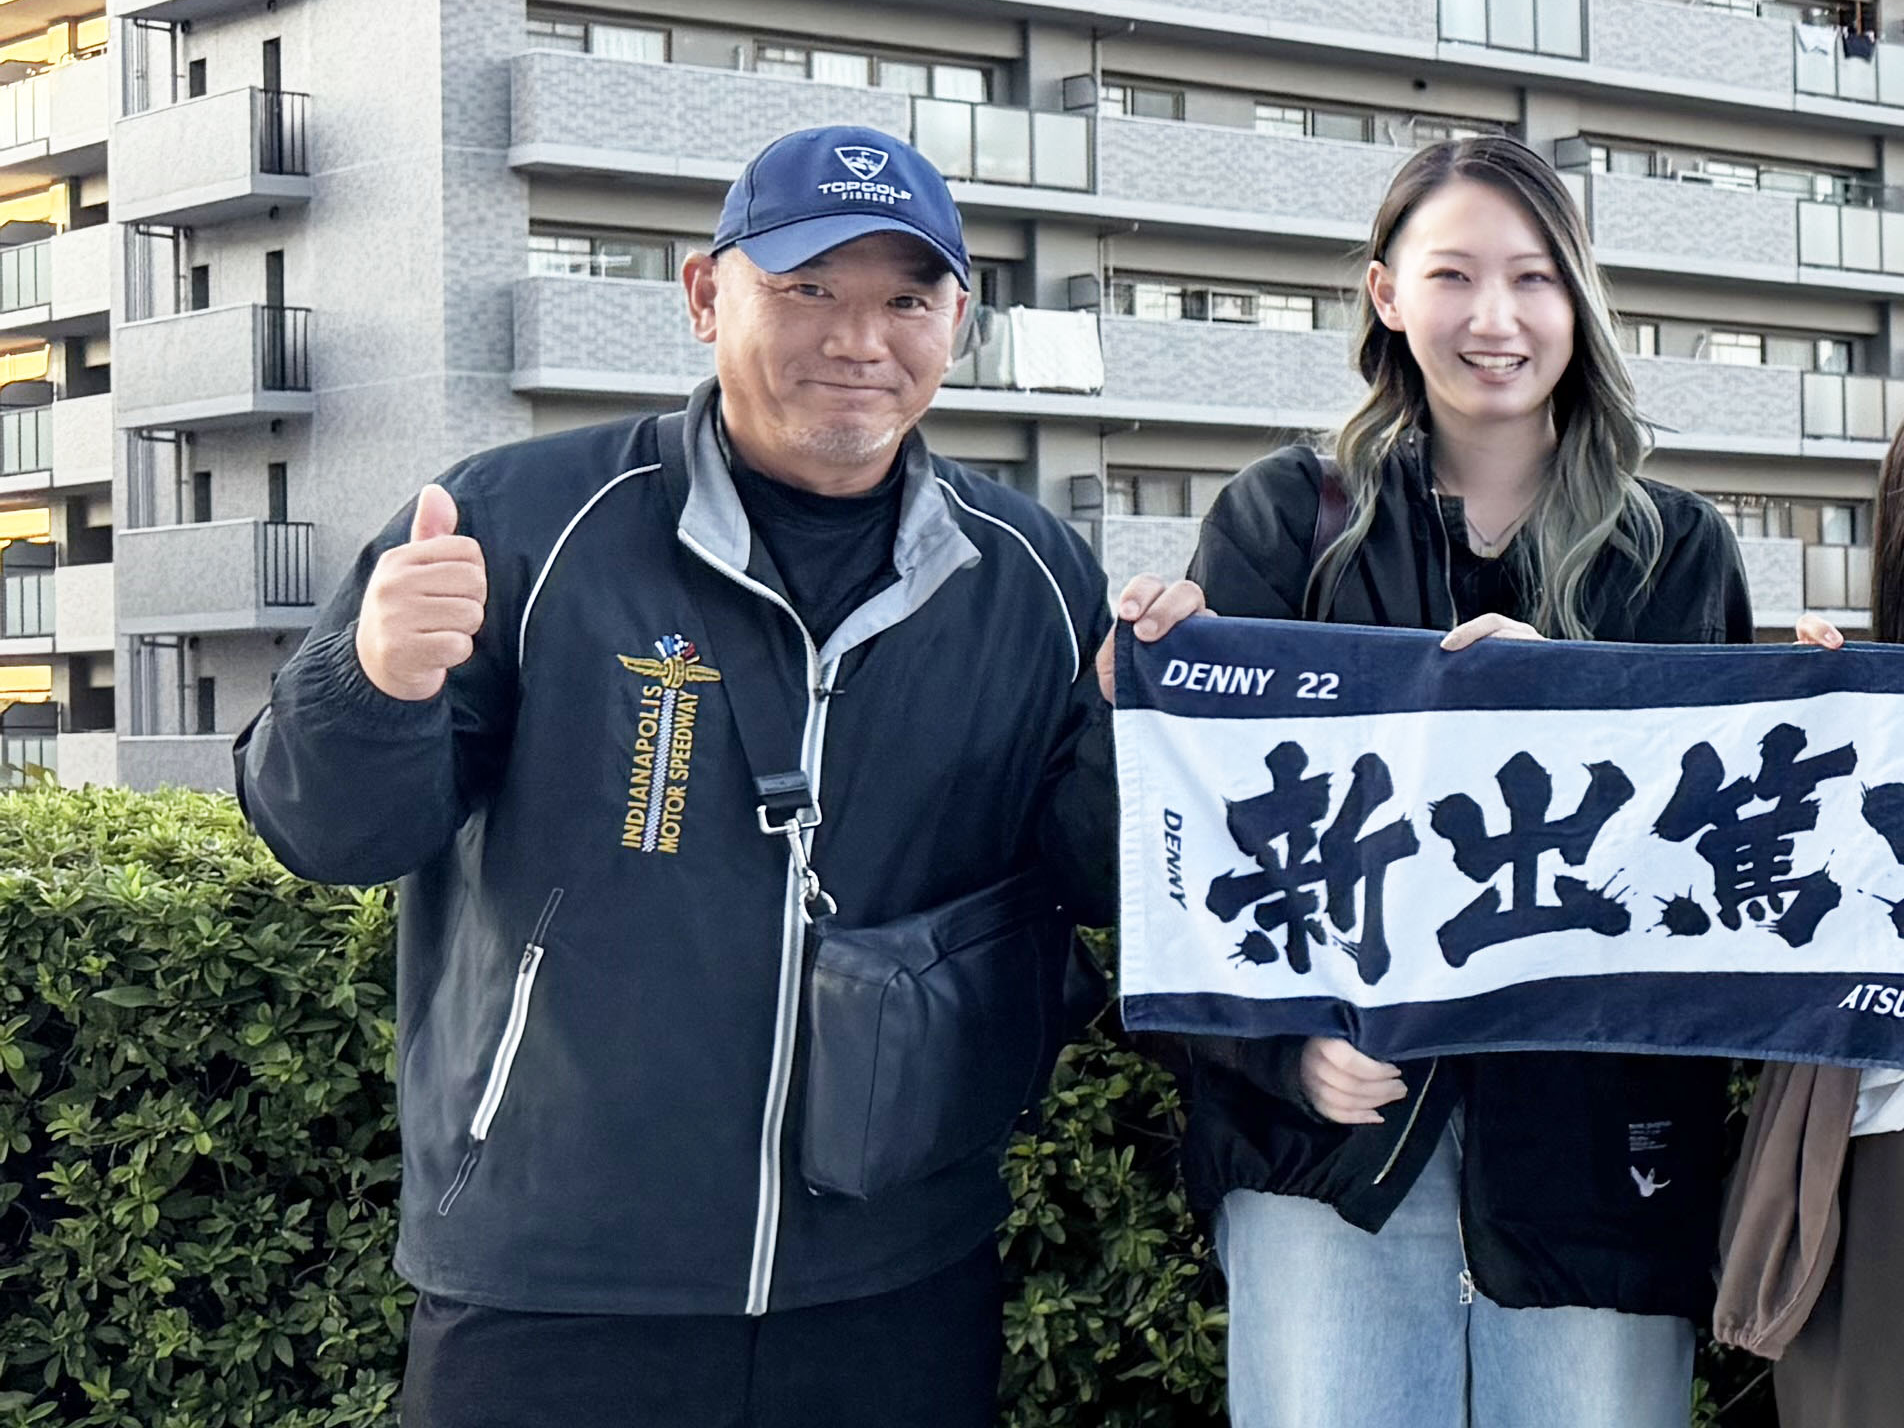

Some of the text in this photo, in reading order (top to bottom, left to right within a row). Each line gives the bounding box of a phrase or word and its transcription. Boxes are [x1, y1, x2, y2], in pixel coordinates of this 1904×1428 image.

[817, 181, 912, 200] TOPGOLF
[1160, 659, 1340, 699] DENNY 22
[621, 684, 663, 849] INDIANAPOLIS
[657, 689, 699, 854] MOTOR SPEEDWAY
[1164, 808, 1188, 911] DENNY
